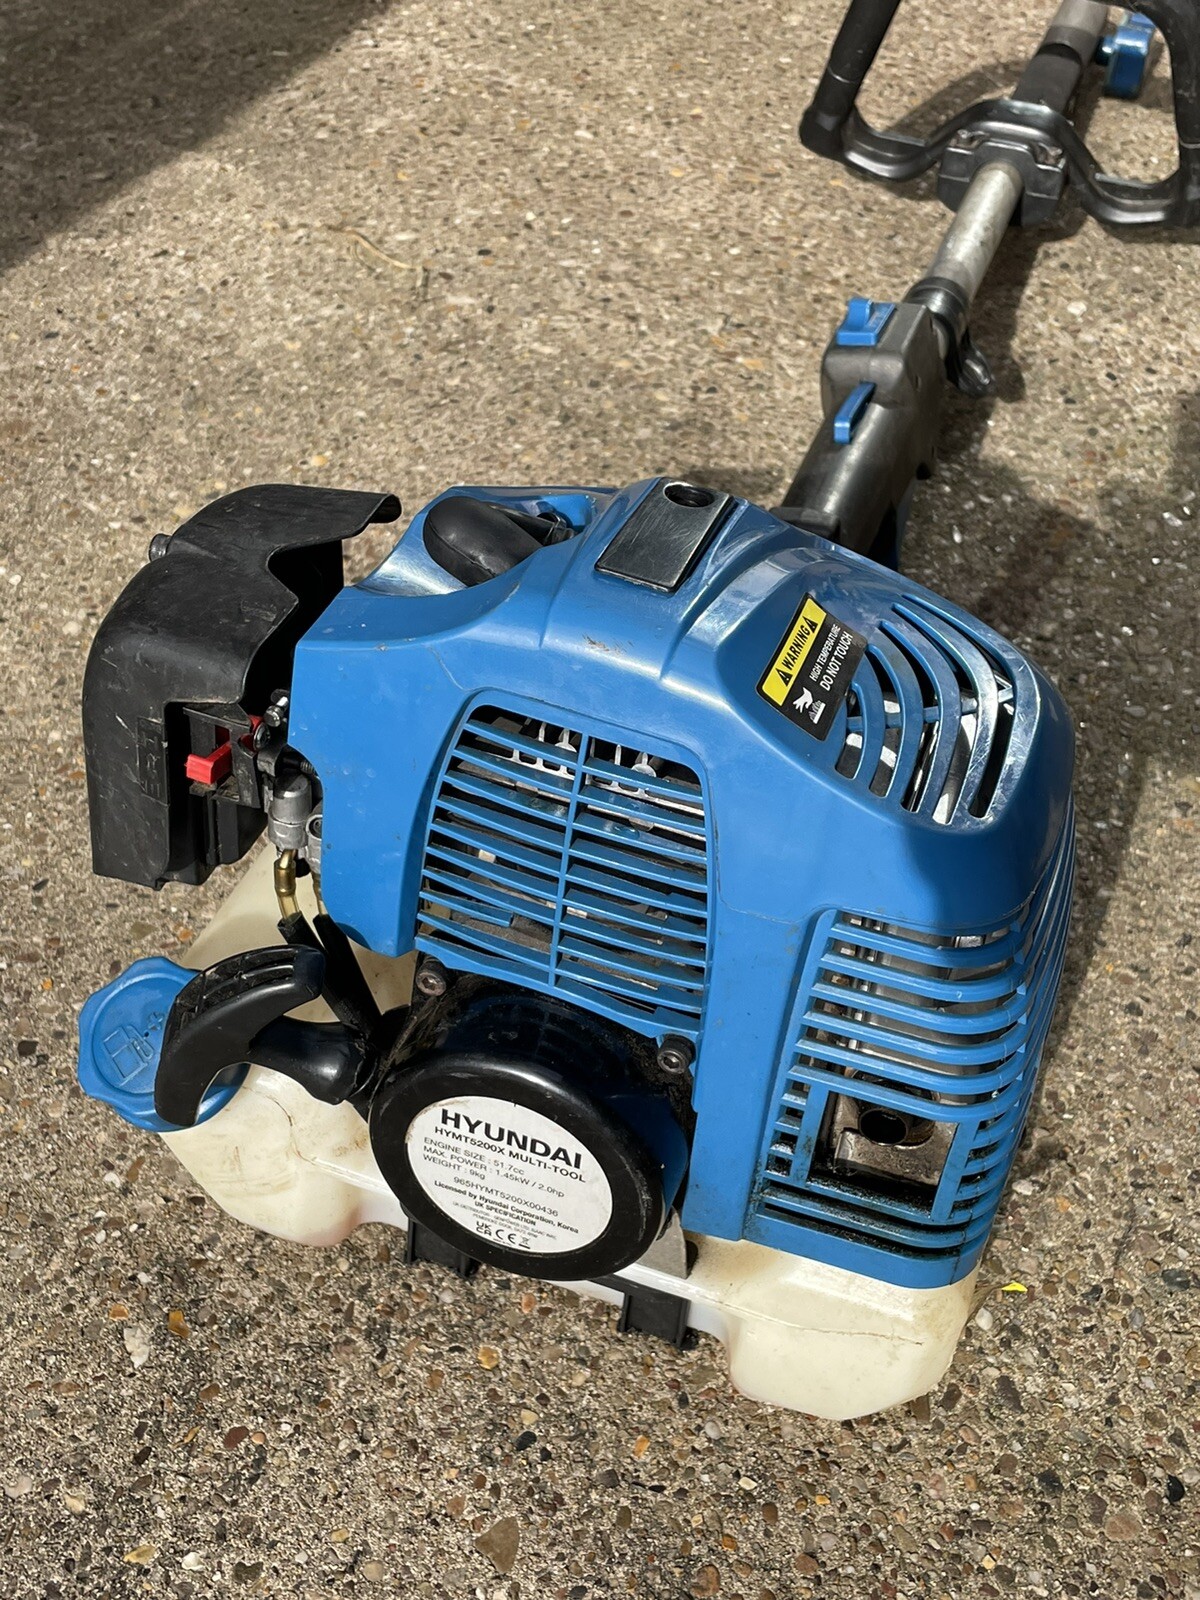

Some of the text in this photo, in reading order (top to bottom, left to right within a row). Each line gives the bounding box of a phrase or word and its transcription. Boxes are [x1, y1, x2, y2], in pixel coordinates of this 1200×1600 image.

[781, 624, 811, 671] WARNING
[809, 624, 841, 682] HIGH TEMPERATURE
[820, 630, 853, 692] DO NOT TOUCH
[424, 1137, 462, 1155] ENGINE
[464, 1149, 486, 1162] SIZE
[493, 1159, 525, 1175] 51.7cc
[434, 1126, 587, 1184] HYMT5200X MULTI-TOOL
[441, 1108, 582, 1170] HYUNDAI
[423, 1153, 462, 1172] WEIGHT
[469, 1169, 486, 1180] 9kg
[450, 1154, 488, 1172] POWER
[496, 1169, 530, 1186] 1.45kW
[538, 1183, 565, 1198] 2.0hp
[434, 1180, 467, 1196] Licensed
[468, 1191, 478, 1200] by
[479, 1194, 509, 1210] Hyundai
[510, 1205, 556, 1227] Corporation,
[557, 1221, 579, 1234] Korea
[474, 1201, 536, 1226] UK SPECIFICATION
